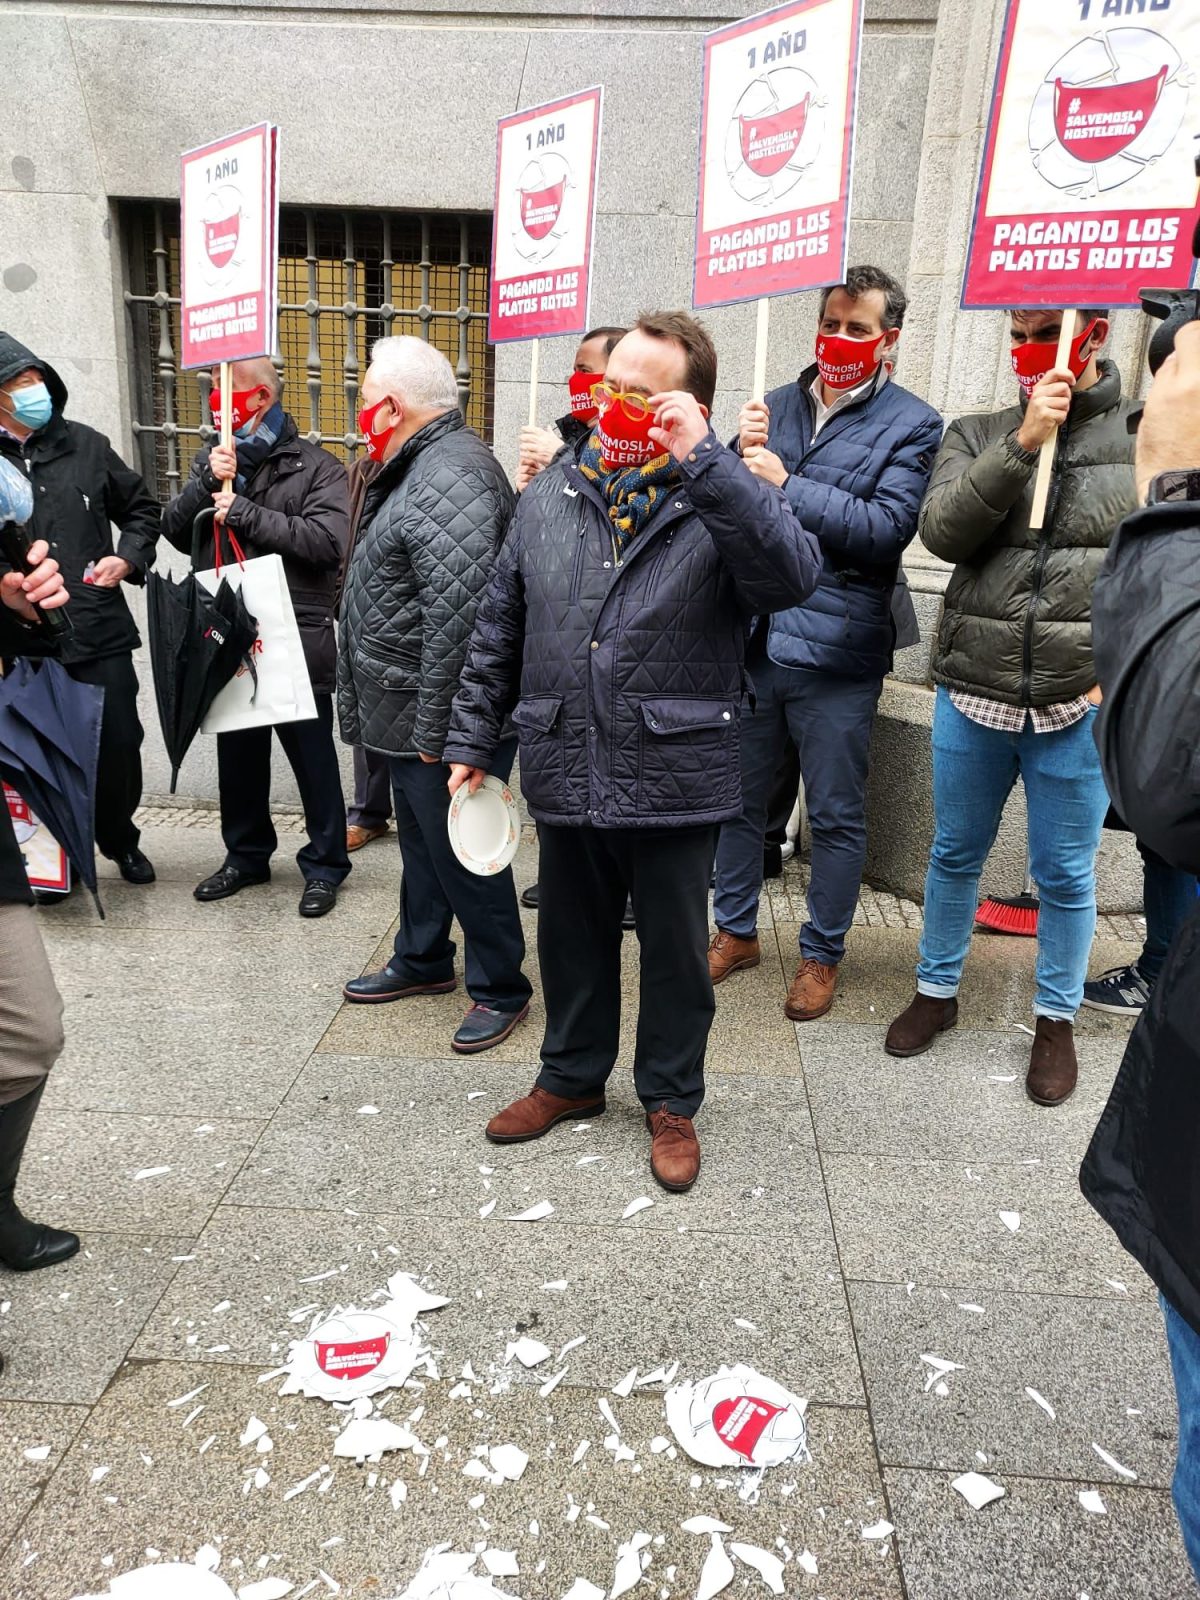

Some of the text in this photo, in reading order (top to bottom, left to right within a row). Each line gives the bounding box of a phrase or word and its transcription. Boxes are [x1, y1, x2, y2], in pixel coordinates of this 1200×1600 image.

[747, 29, 807, 69] 1 AÑO
[1066, 109, 1143, 129] SALVEMOSLA
[1068, 97, 1081, 114] #
[526, 122, 565, 151] 1 AÑO
[749, 128, 798, 151] SALVEMOSLA
[1064, 123, 1136, 141] HOSTELERÍA
[205, 157, 238, 184] 1 AÑO
[709, 209, 831, 256] PAGANDO LOS
[993, 217, 1180, 246] PAGANDO LOS
[708, 234, 829, 277] PLATOS ROTOS
[988, 246, 1175, 272] PLATOS ROTOS
[499, 271, 578, 301] PAGANDO LOS
[189, 297, 257, 327] PAGANDO LOS
[498, 291, 577, 318] PLATOS ROTOS
[189, 315, 257, 344] PLATOS ROTOS
